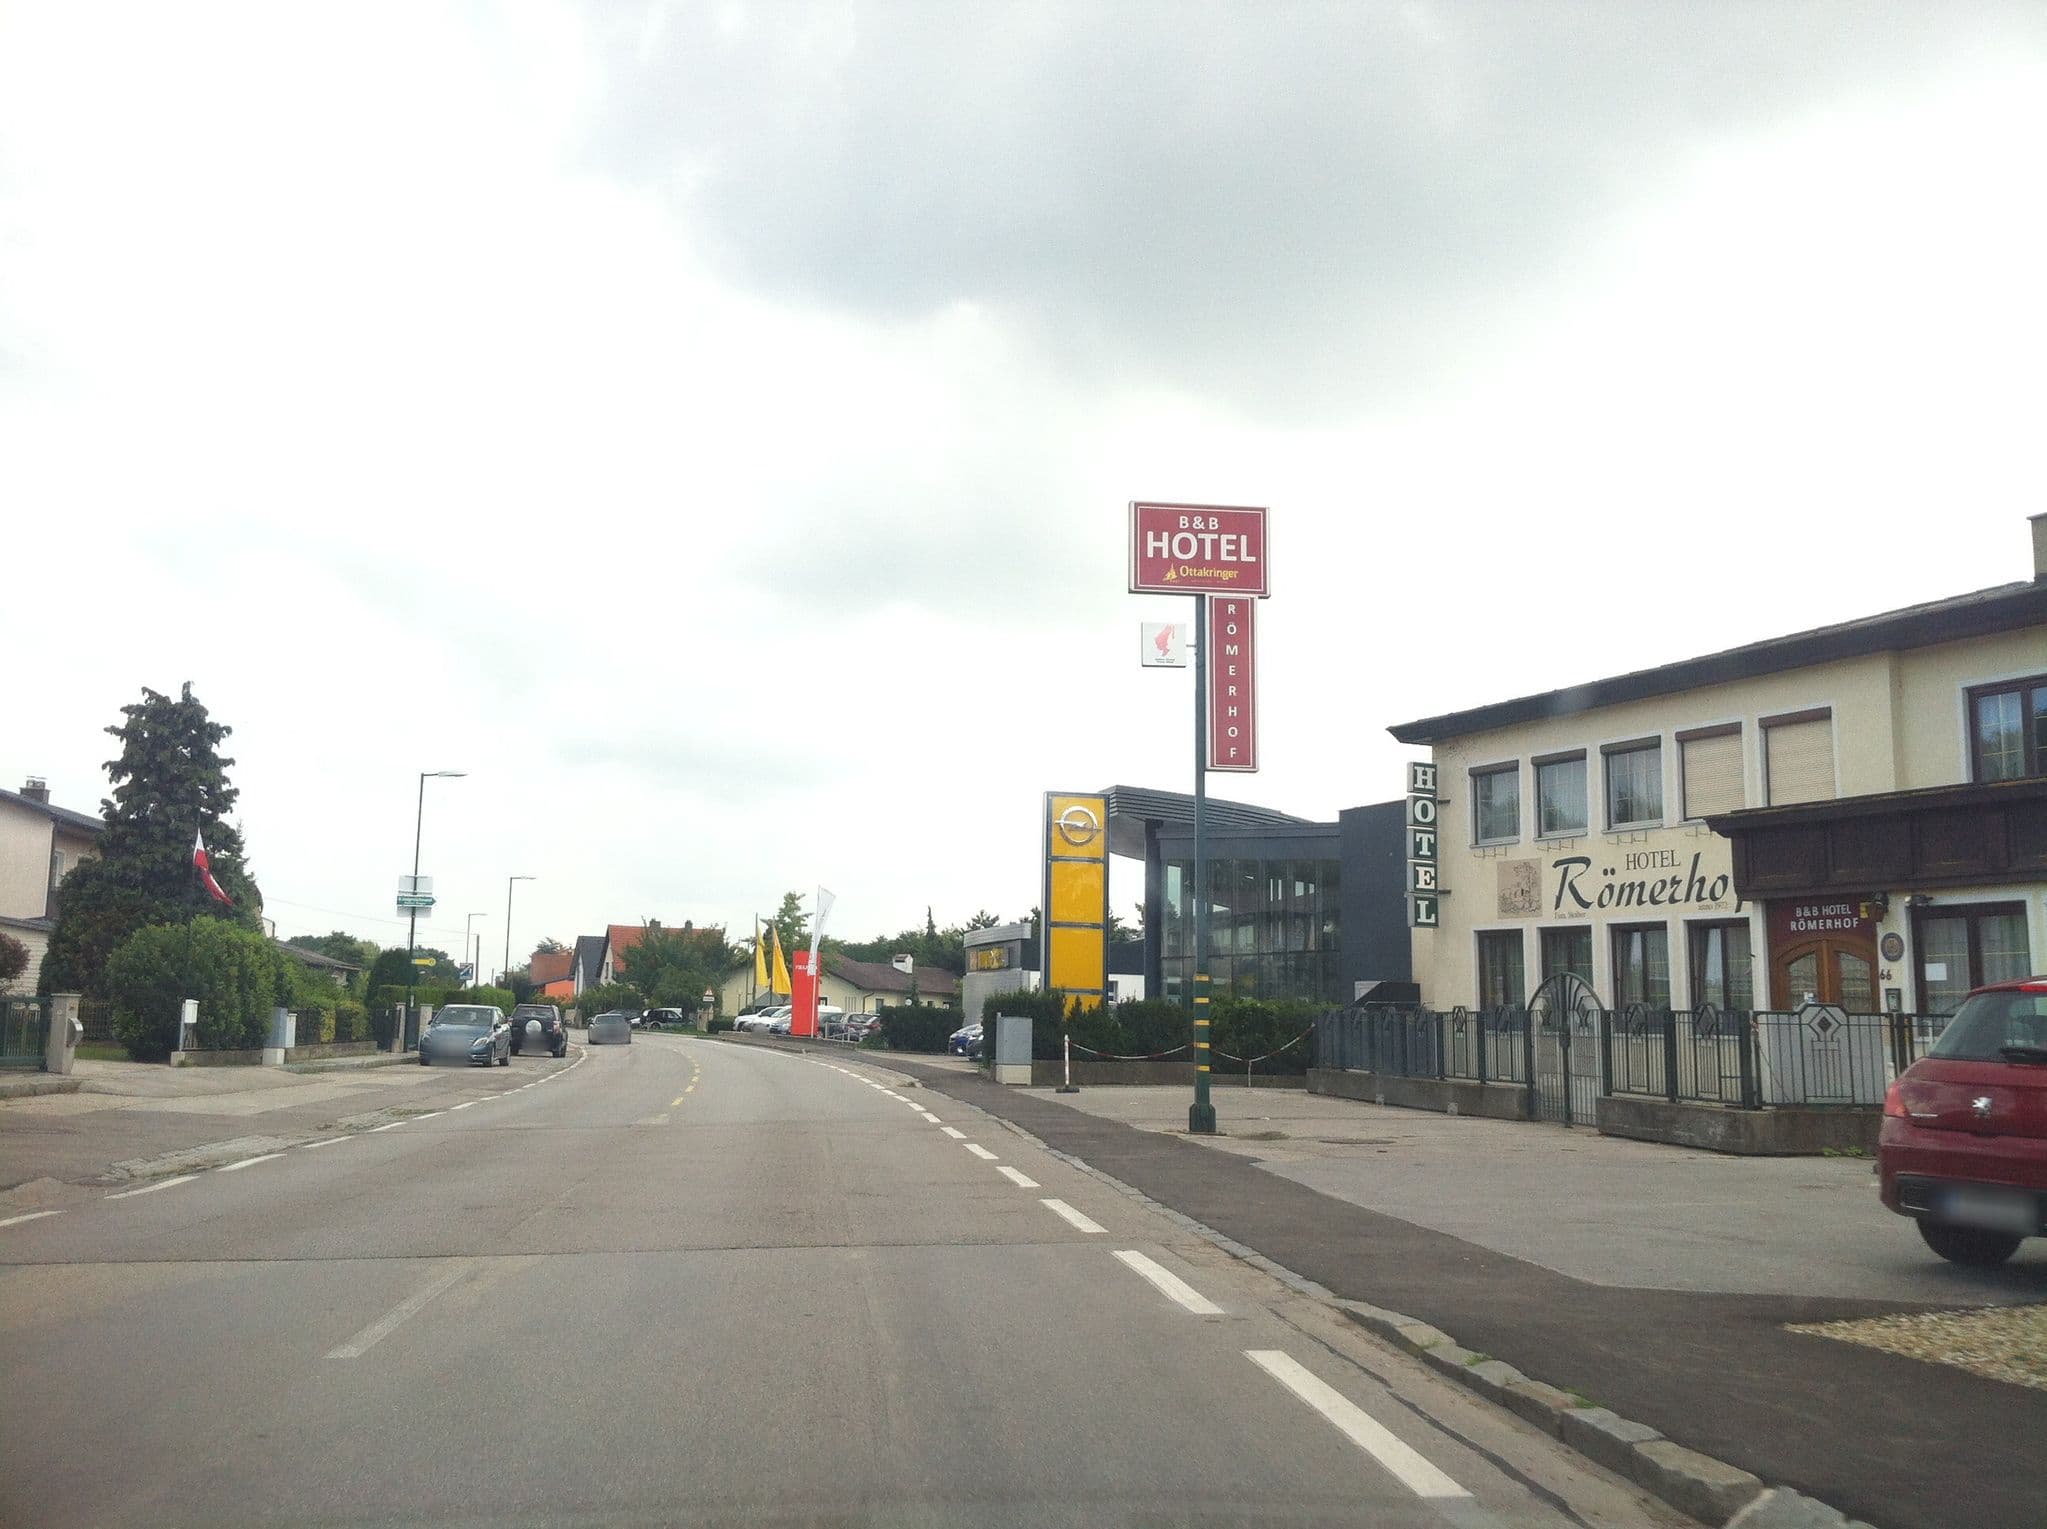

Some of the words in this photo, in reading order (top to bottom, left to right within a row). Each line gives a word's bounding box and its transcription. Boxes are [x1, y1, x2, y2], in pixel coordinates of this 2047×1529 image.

[1146, 531, 1256, 562] HOTEL
[1179, 565, 1239, 581] Ottakringer
[1226, 603, 1239, 759] RÖMERHOF
[1413, 765, 1436, 924] HOTEL
[1625, 850, 1681, 871] HOTEL
[1552, 852, 1742, 914] Römerho
[1795, 905, 1819, 917] B&B
[1822, 904, 1852, 916] HOTEL
[1790, 917, 1860, 931] RÖMERHOF
[1879, 968, 1893, 981] 66
